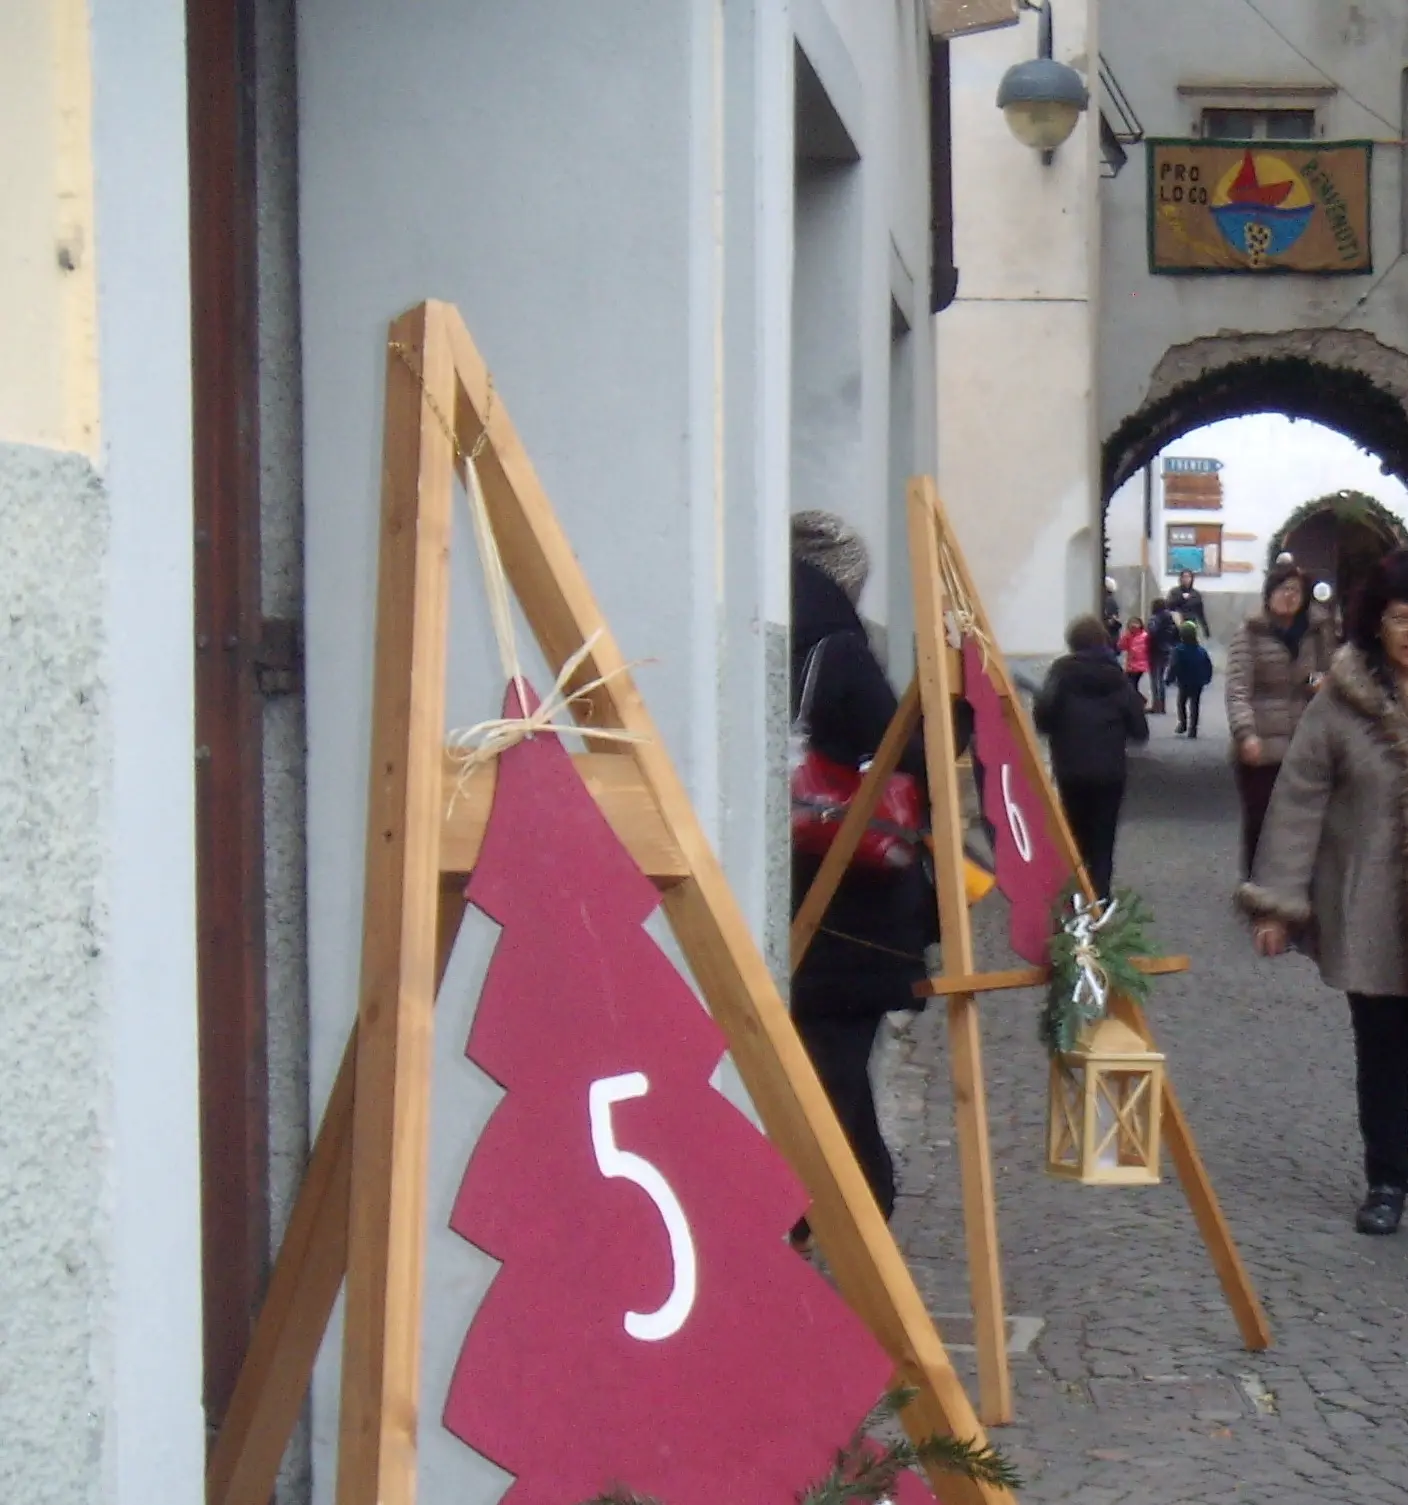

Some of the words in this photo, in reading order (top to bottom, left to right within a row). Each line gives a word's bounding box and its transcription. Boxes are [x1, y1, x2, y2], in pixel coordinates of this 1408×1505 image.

[1160, 162, 1200, 182] PRO
[1159, 186, 1209, 206] LOCO
[1170, 459, 1209, 472] TRENTO
[1001, 763, 1032, 863] 6
[589, 1071, 697, 1341] 5
